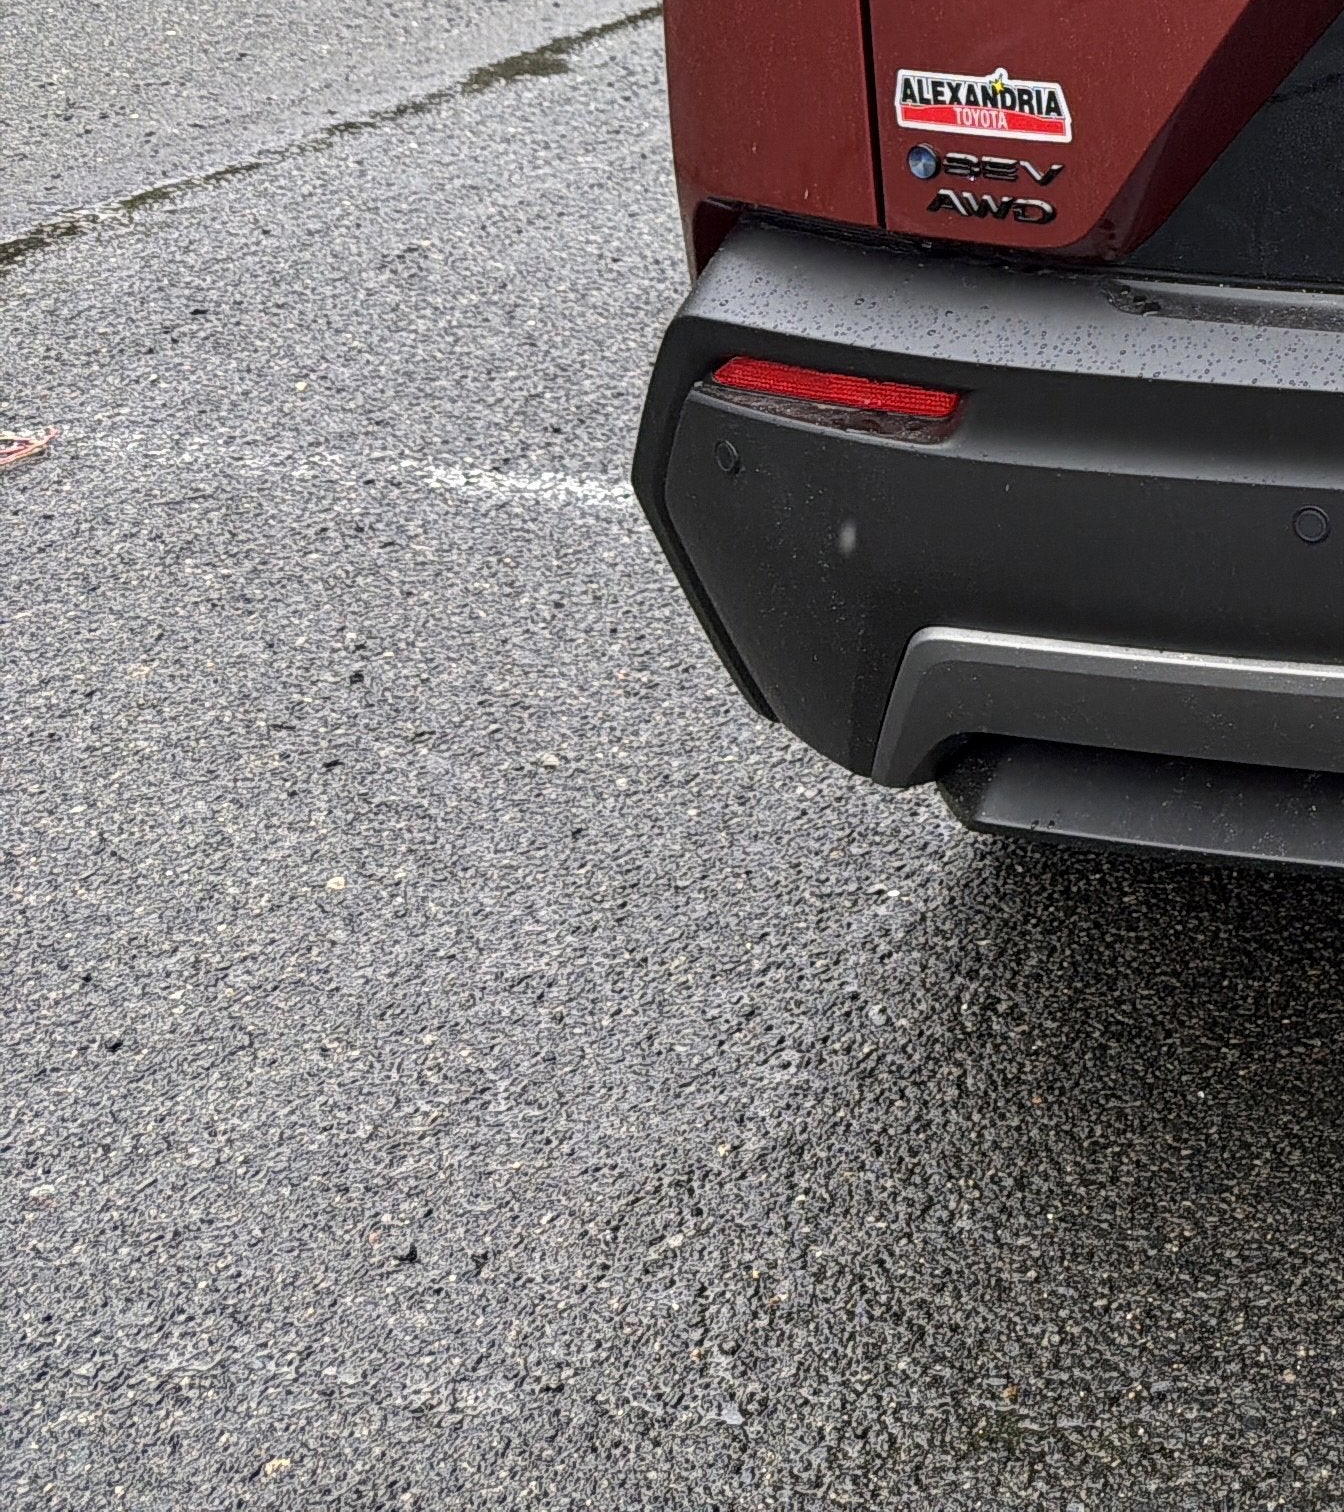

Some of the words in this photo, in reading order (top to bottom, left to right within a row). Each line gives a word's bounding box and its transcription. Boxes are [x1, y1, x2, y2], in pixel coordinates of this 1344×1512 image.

[900, 76, 1063, 117] ALEXANDRIA
[952, 106, 1009, 130] TOYOTA
[942, 151, 1066, 187] BEV
[927, 188, 1058, 225] AWD
